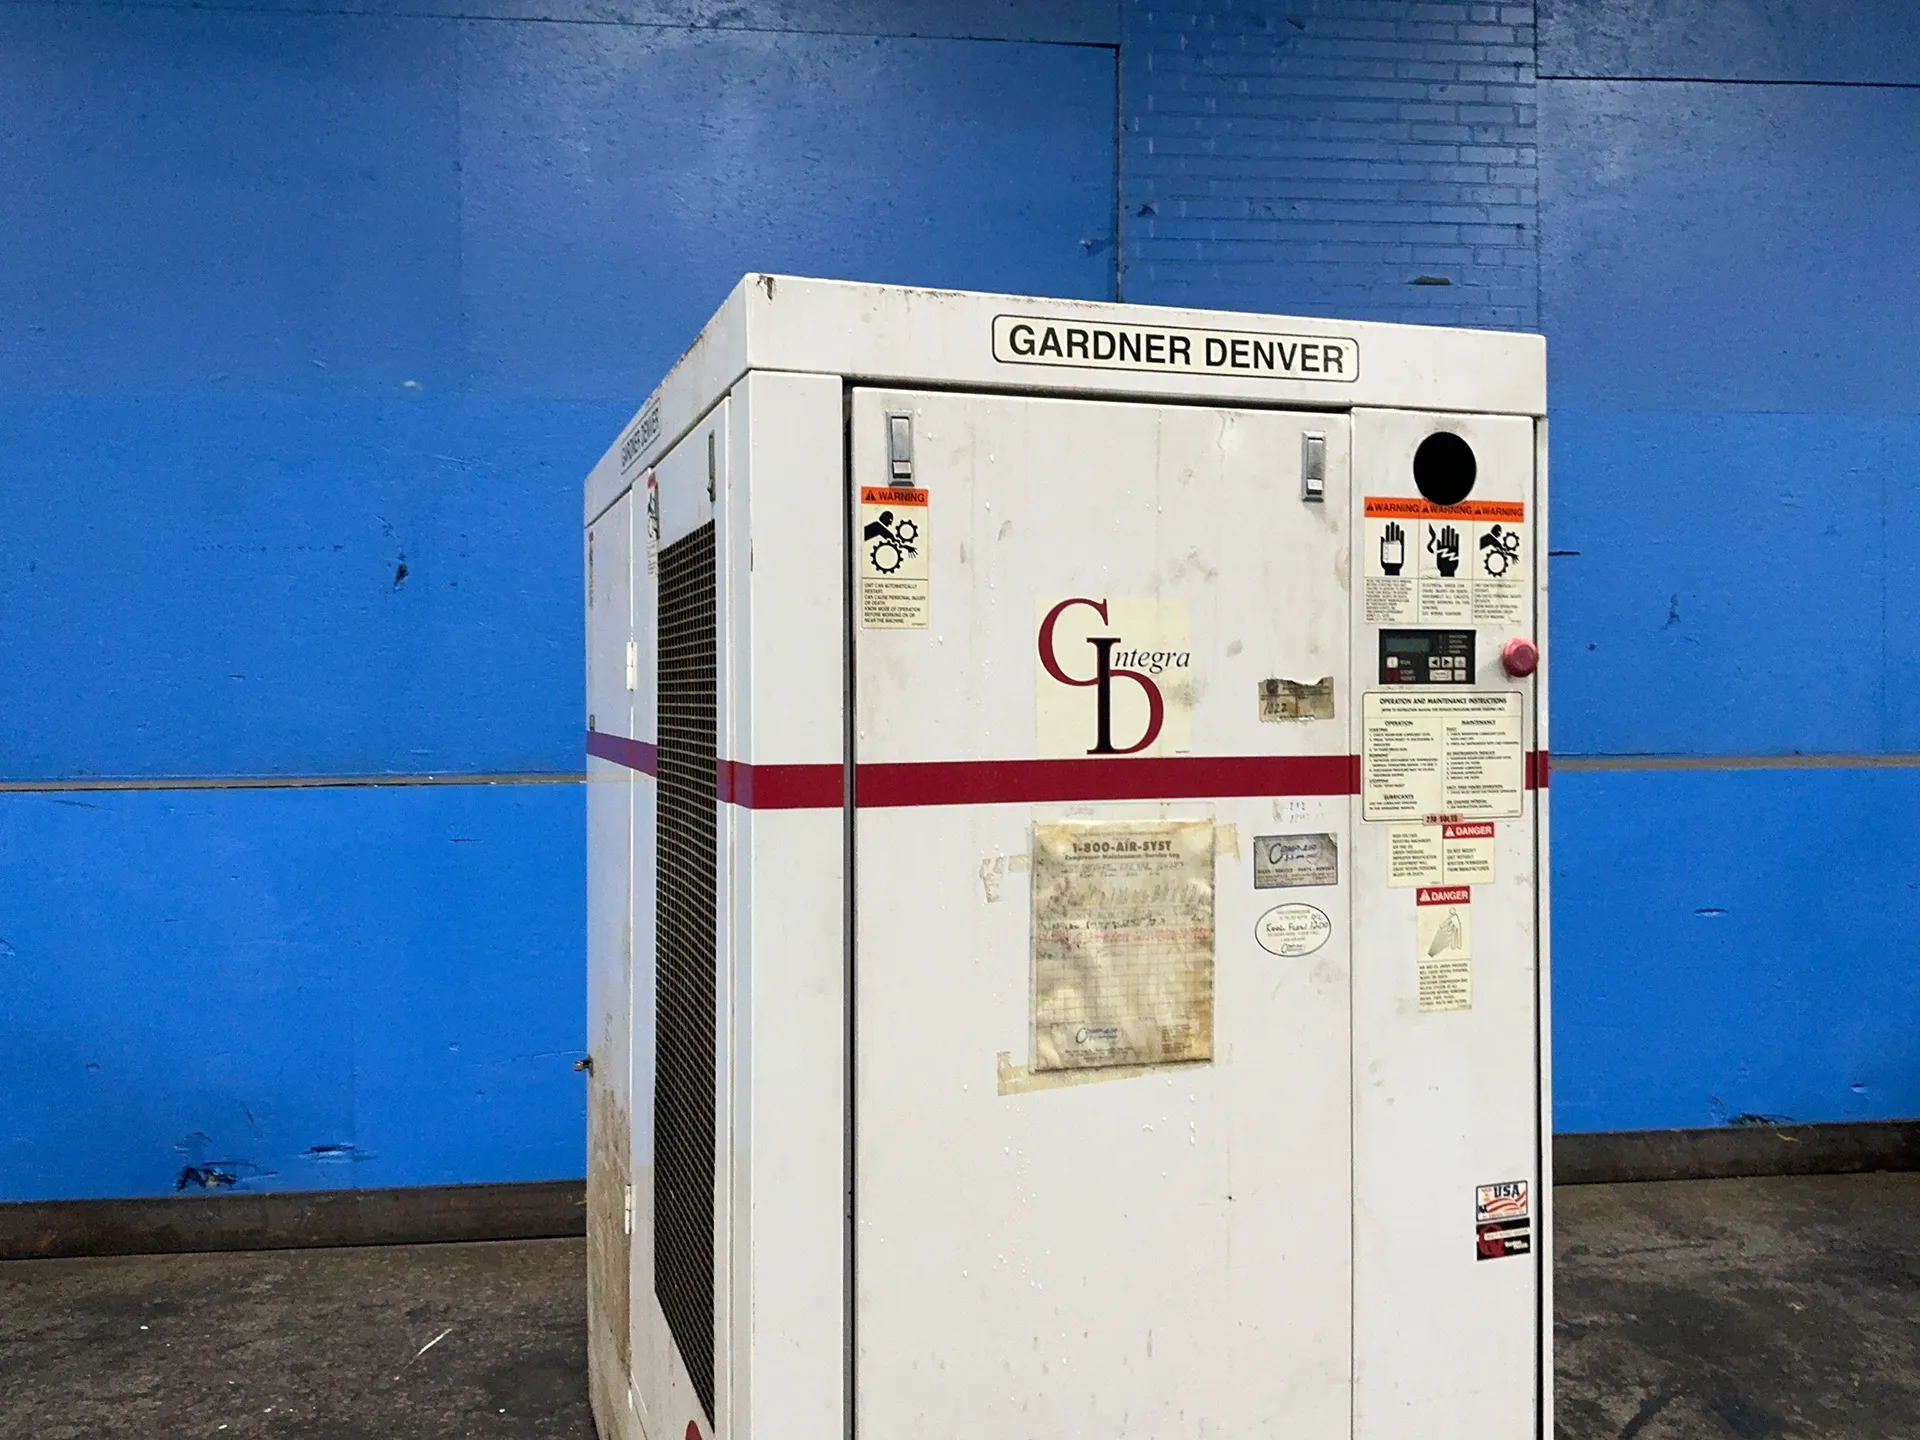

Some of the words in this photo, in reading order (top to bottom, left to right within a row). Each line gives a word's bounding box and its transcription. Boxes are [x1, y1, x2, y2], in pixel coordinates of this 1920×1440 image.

[1009, 324, 1191, 365] GARDNER
[1205, 338, 1344, 373] DENVER
[878, 491, 925, 503] WARNING
[1375, 503, 1420, 514] WARNING
[1428, 505, 1472, 515] WARNING
[1482, 507, 1523, 517] WARNING
[1439, 814, 1458, 823] VOLTS
[1455, 826, 1493, 836] DANGER
[1072, 841, 1172, 853] 1-800-AIR-SYST
[1431, 890, 1468, 901] DANGER
[1494, 1184, 1520, 1198] USA
